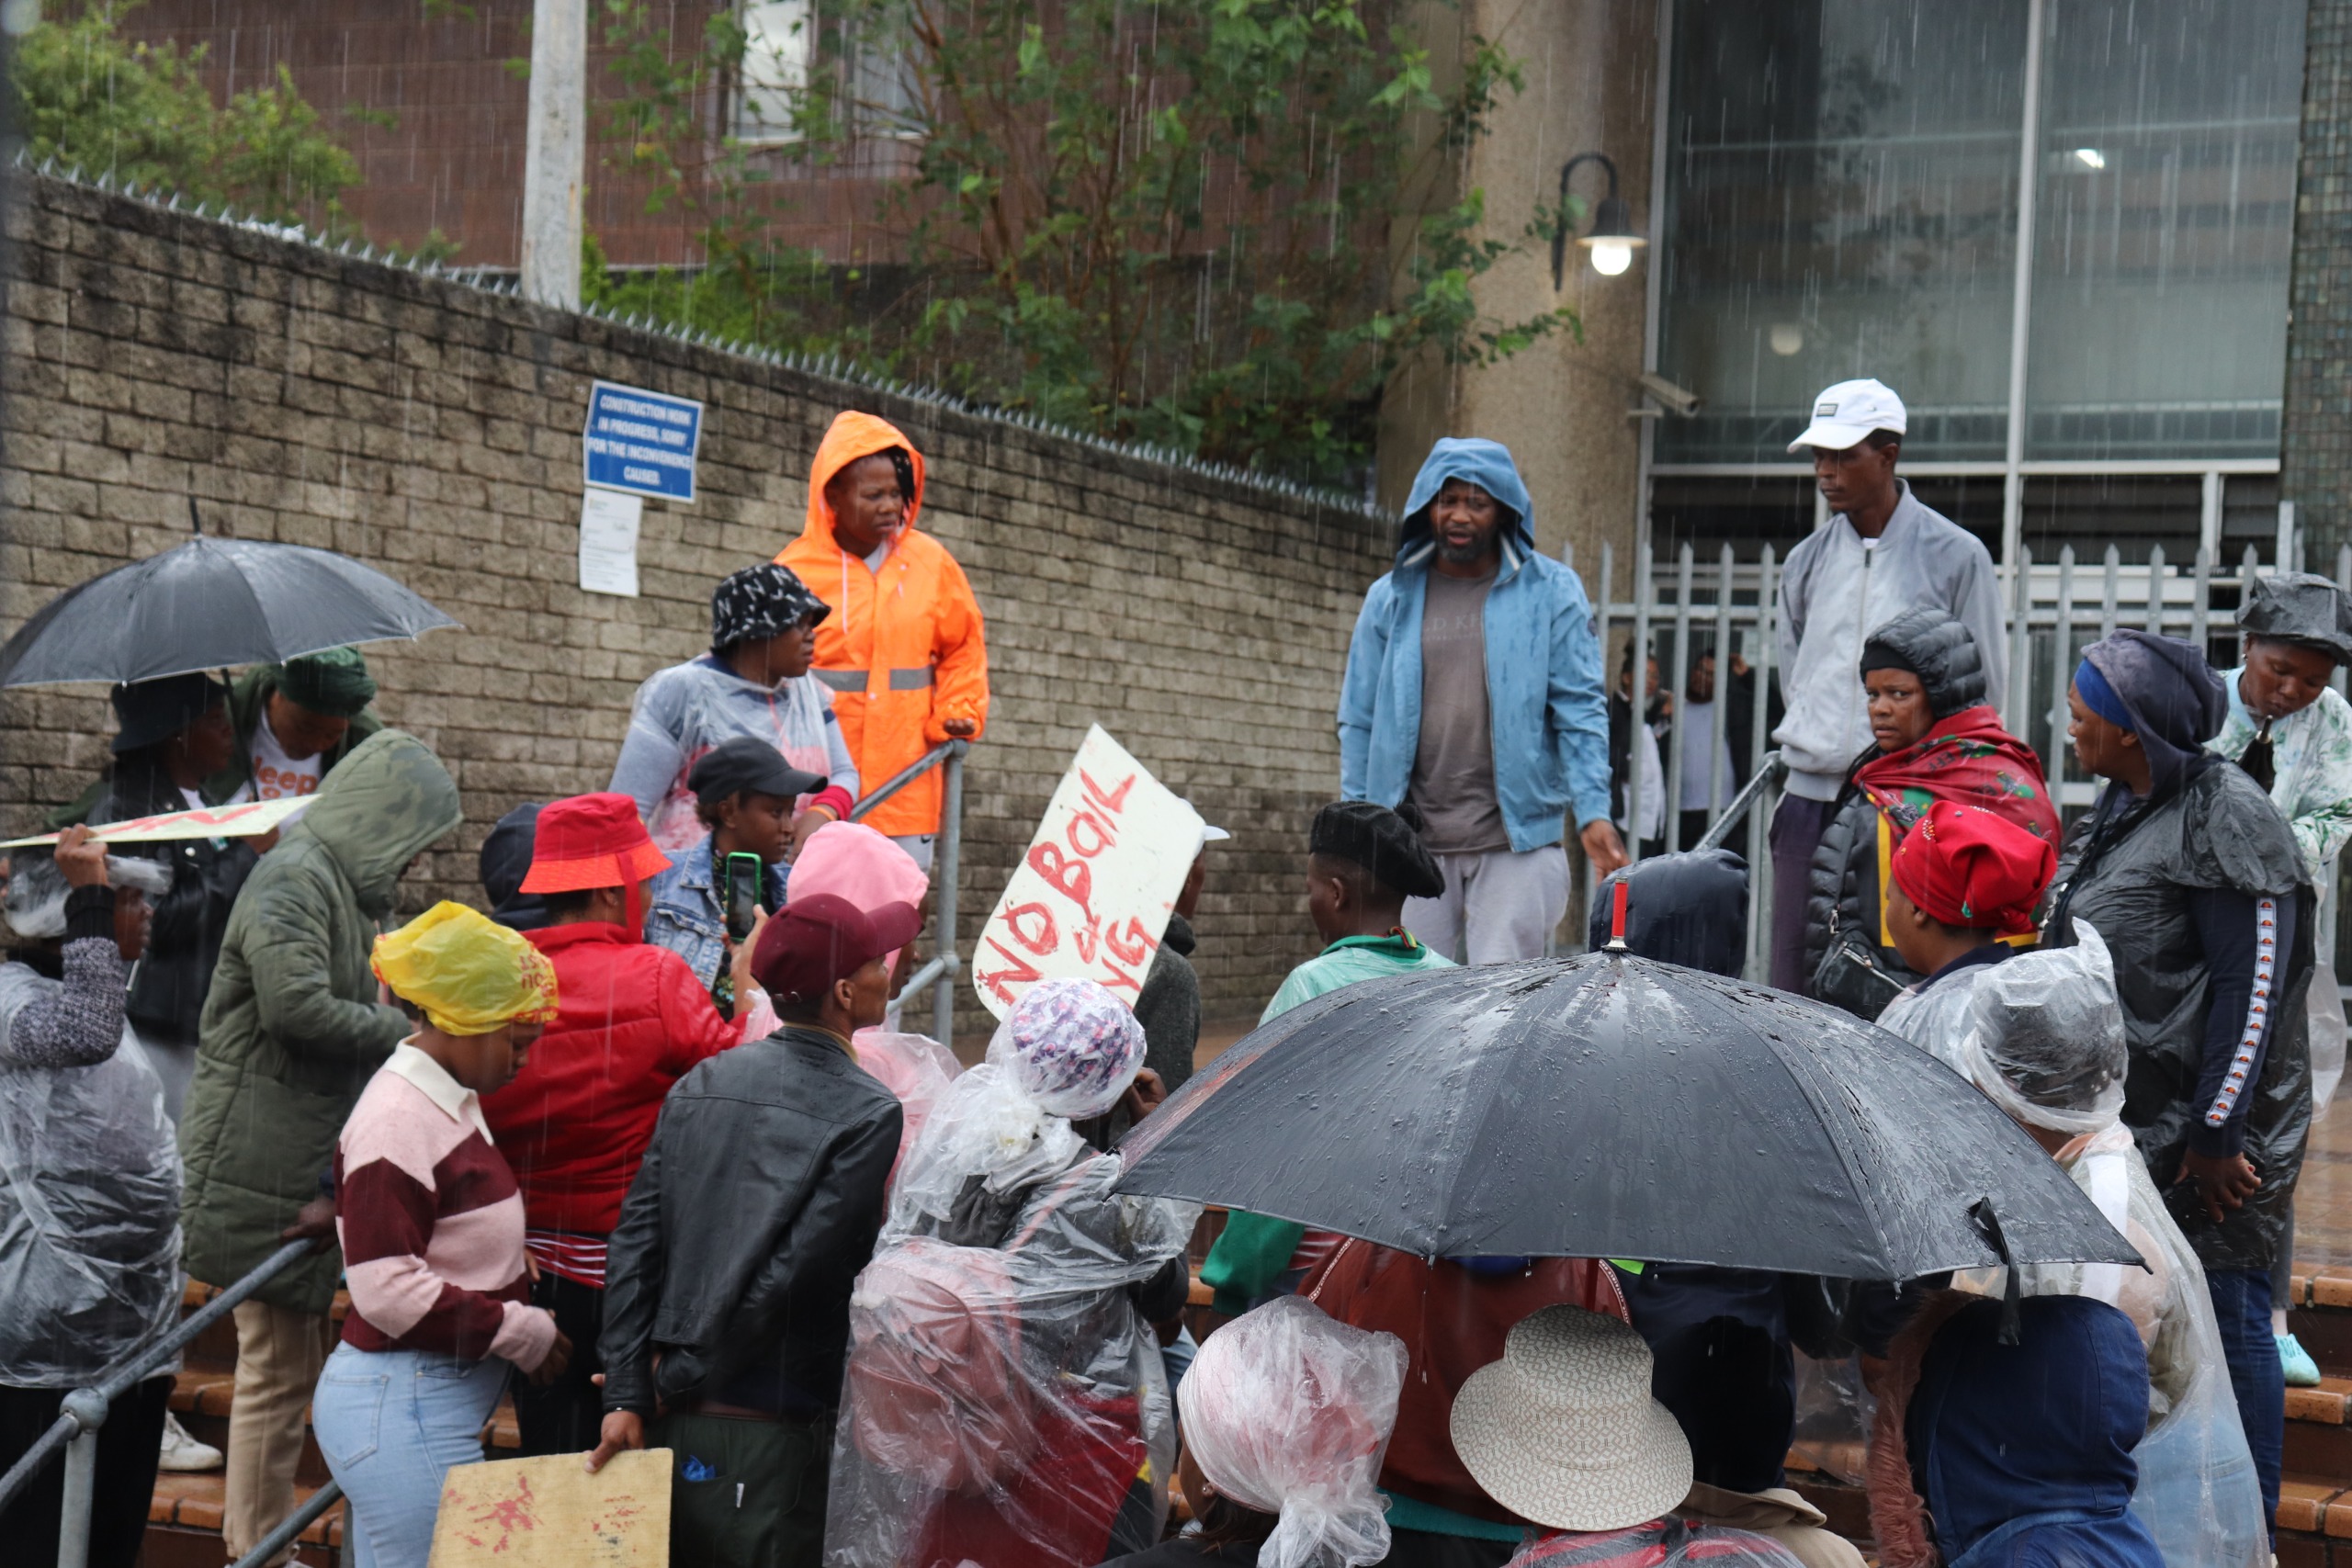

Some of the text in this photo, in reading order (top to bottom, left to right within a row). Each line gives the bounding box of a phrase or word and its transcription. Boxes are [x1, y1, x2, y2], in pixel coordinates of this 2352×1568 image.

[600, 394, 692, 426] CONSTRUCTION WORK
[597, 417, 687, 447] IN PROGRESS, SORRY
[587, 436, 692, 470] FOR THE INCONVENIENCE
[975, 901, 1060, 1007] NO
